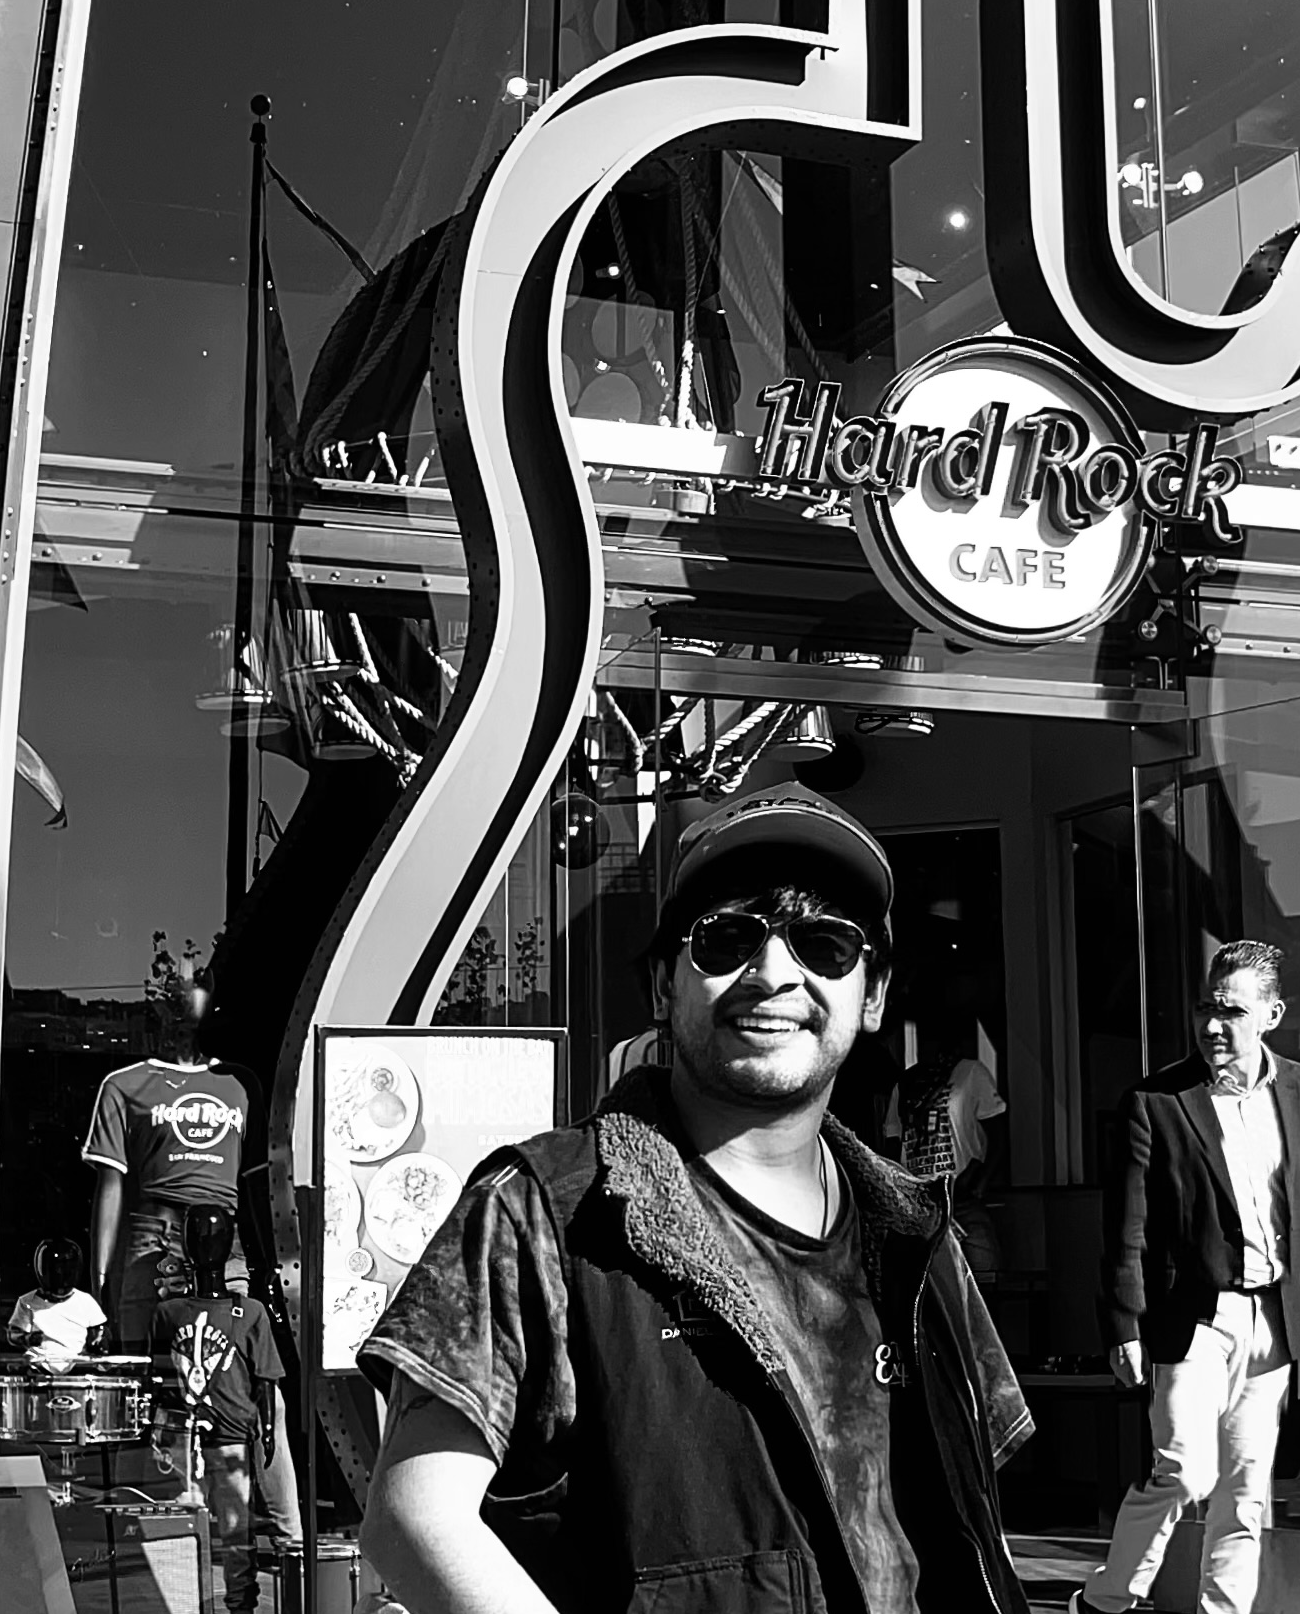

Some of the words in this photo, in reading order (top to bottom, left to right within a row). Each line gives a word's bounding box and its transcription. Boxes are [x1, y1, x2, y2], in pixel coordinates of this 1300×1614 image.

[757, 377, 1011, 499] Hard
[1019, 406, 1242, 544] Rock
[948, 542, 1067, 590] CAFE
[151, 1103, 201, 1127] Hard
[187, 1128, 214, 1138] CAFE
